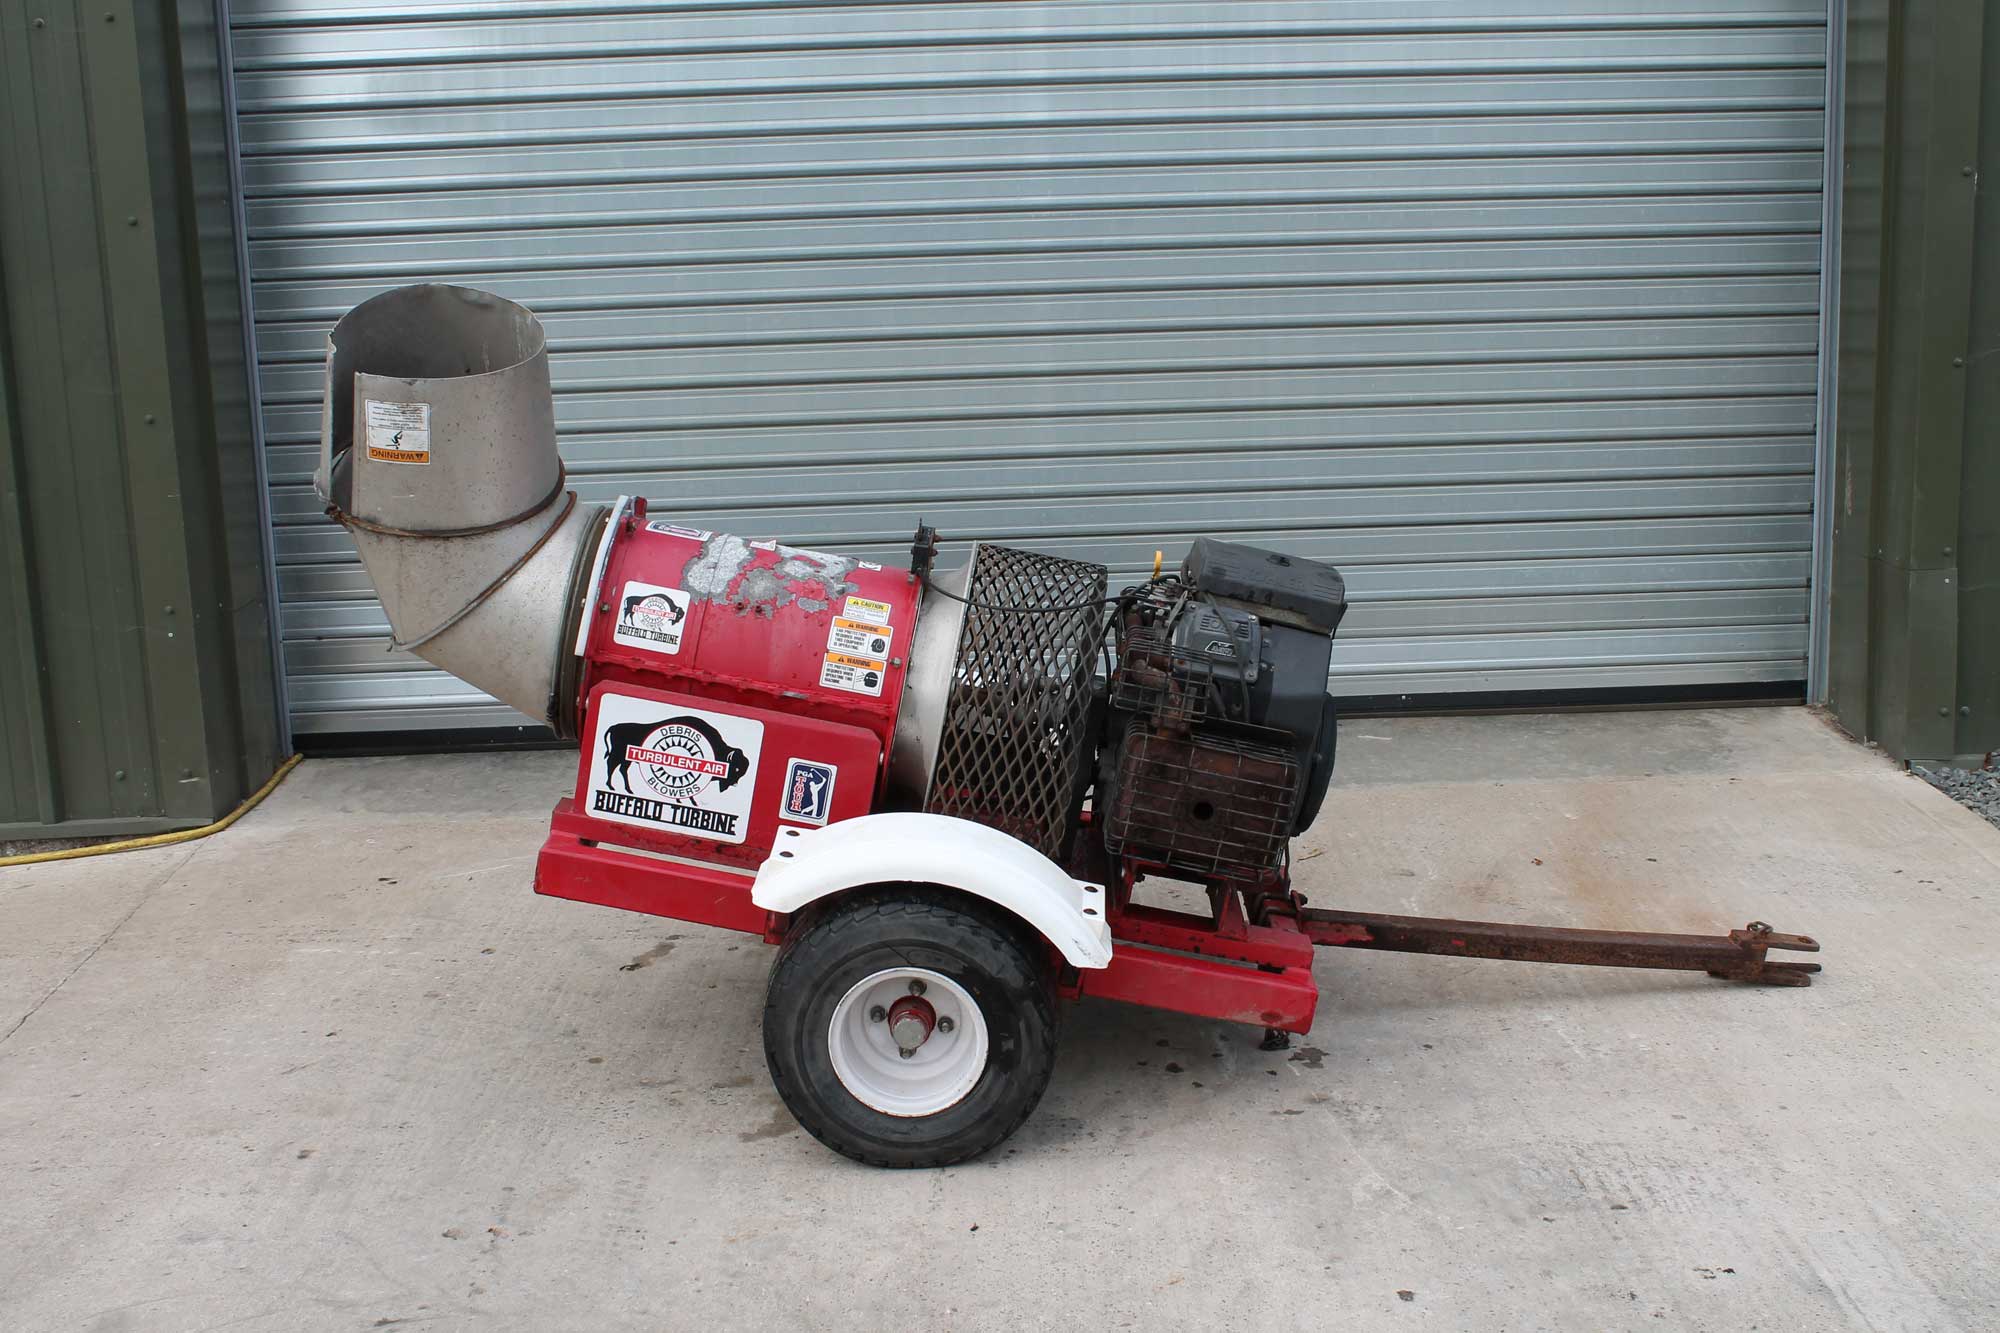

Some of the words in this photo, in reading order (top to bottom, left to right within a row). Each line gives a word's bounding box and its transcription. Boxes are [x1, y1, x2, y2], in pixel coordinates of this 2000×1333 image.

[371, 449, 414, 460] WARNING
[861, 600, 884, 610] CAUTION
[617, 624, 647, 640] BUFFALO
[855, 623, 879, 633] WARNING
[846, 658, 871, 667] WARNING
[660, 726, 702, 743] DEBRIS
[630, 749, 702, 770] TURBULENT
[703, 763, 724, 775] AIR
[797, 770, 813, 778] PGA
[647, 777, 701, 798] BLOWERS
[593, 790, 663, 820] BUFFALO
[671, 805, 739, 836] TURBINE
